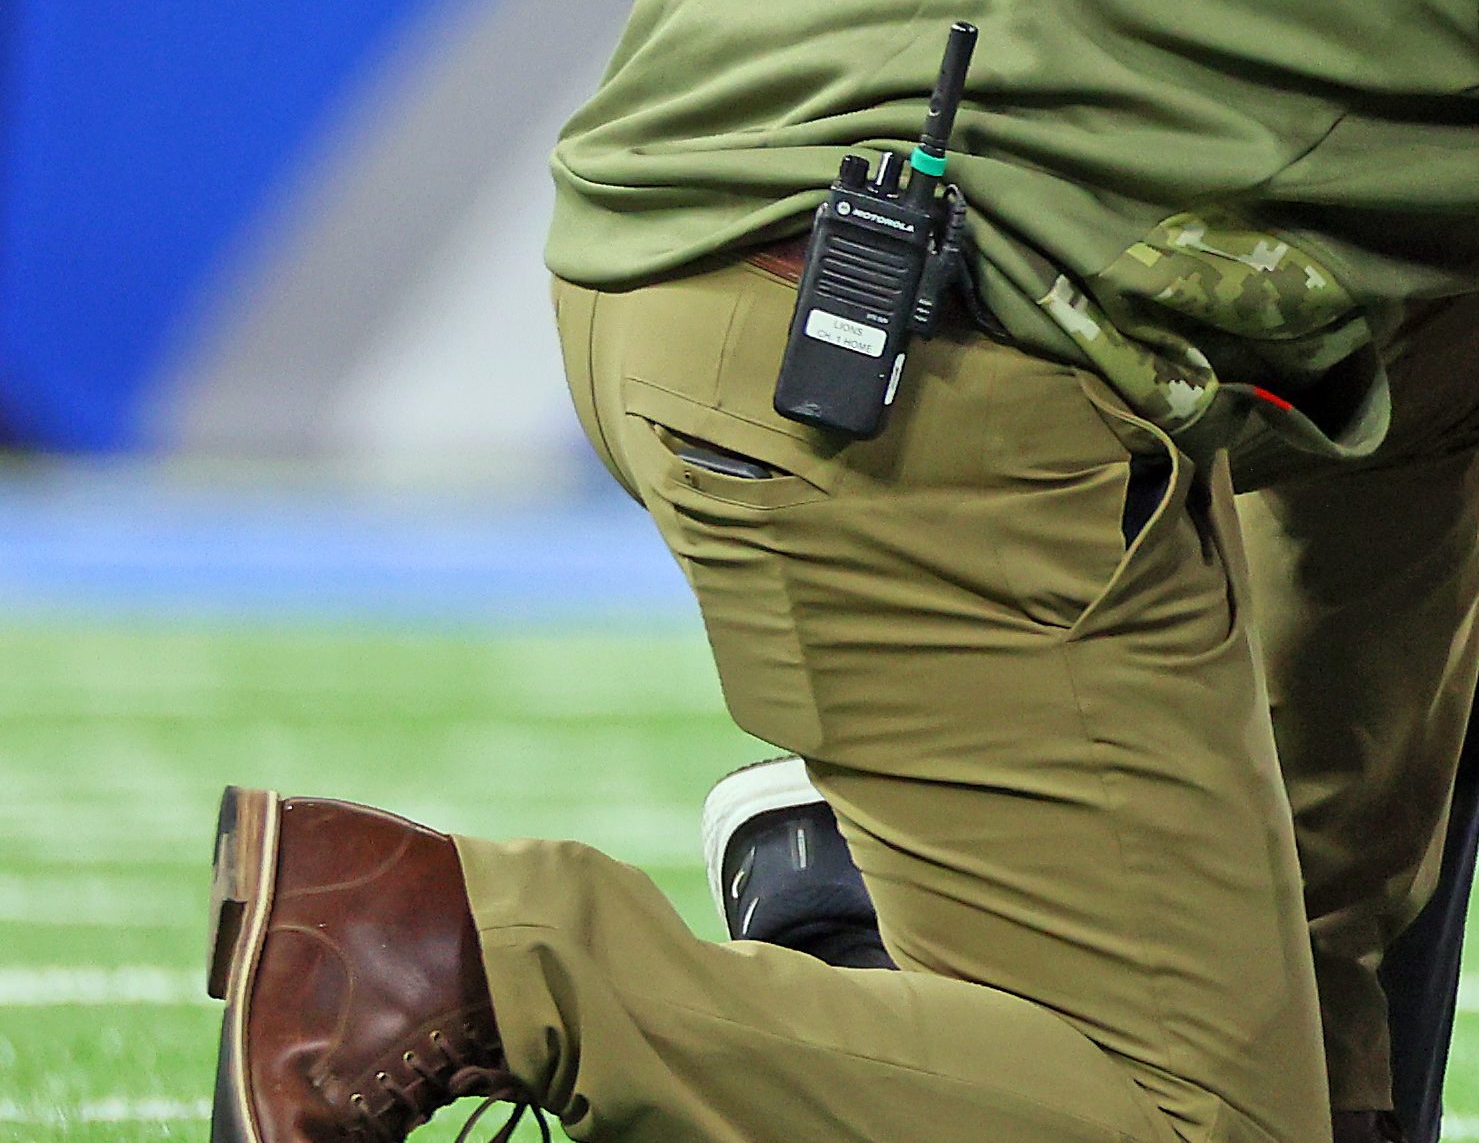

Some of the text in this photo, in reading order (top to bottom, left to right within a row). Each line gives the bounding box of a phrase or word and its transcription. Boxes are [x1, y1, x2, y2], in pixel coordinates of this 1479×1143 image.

[852, 208, 915, 234] MOTOROLA
[834, 320, 864, 337] LIONS
[843, 338, 872, 354] HOME
